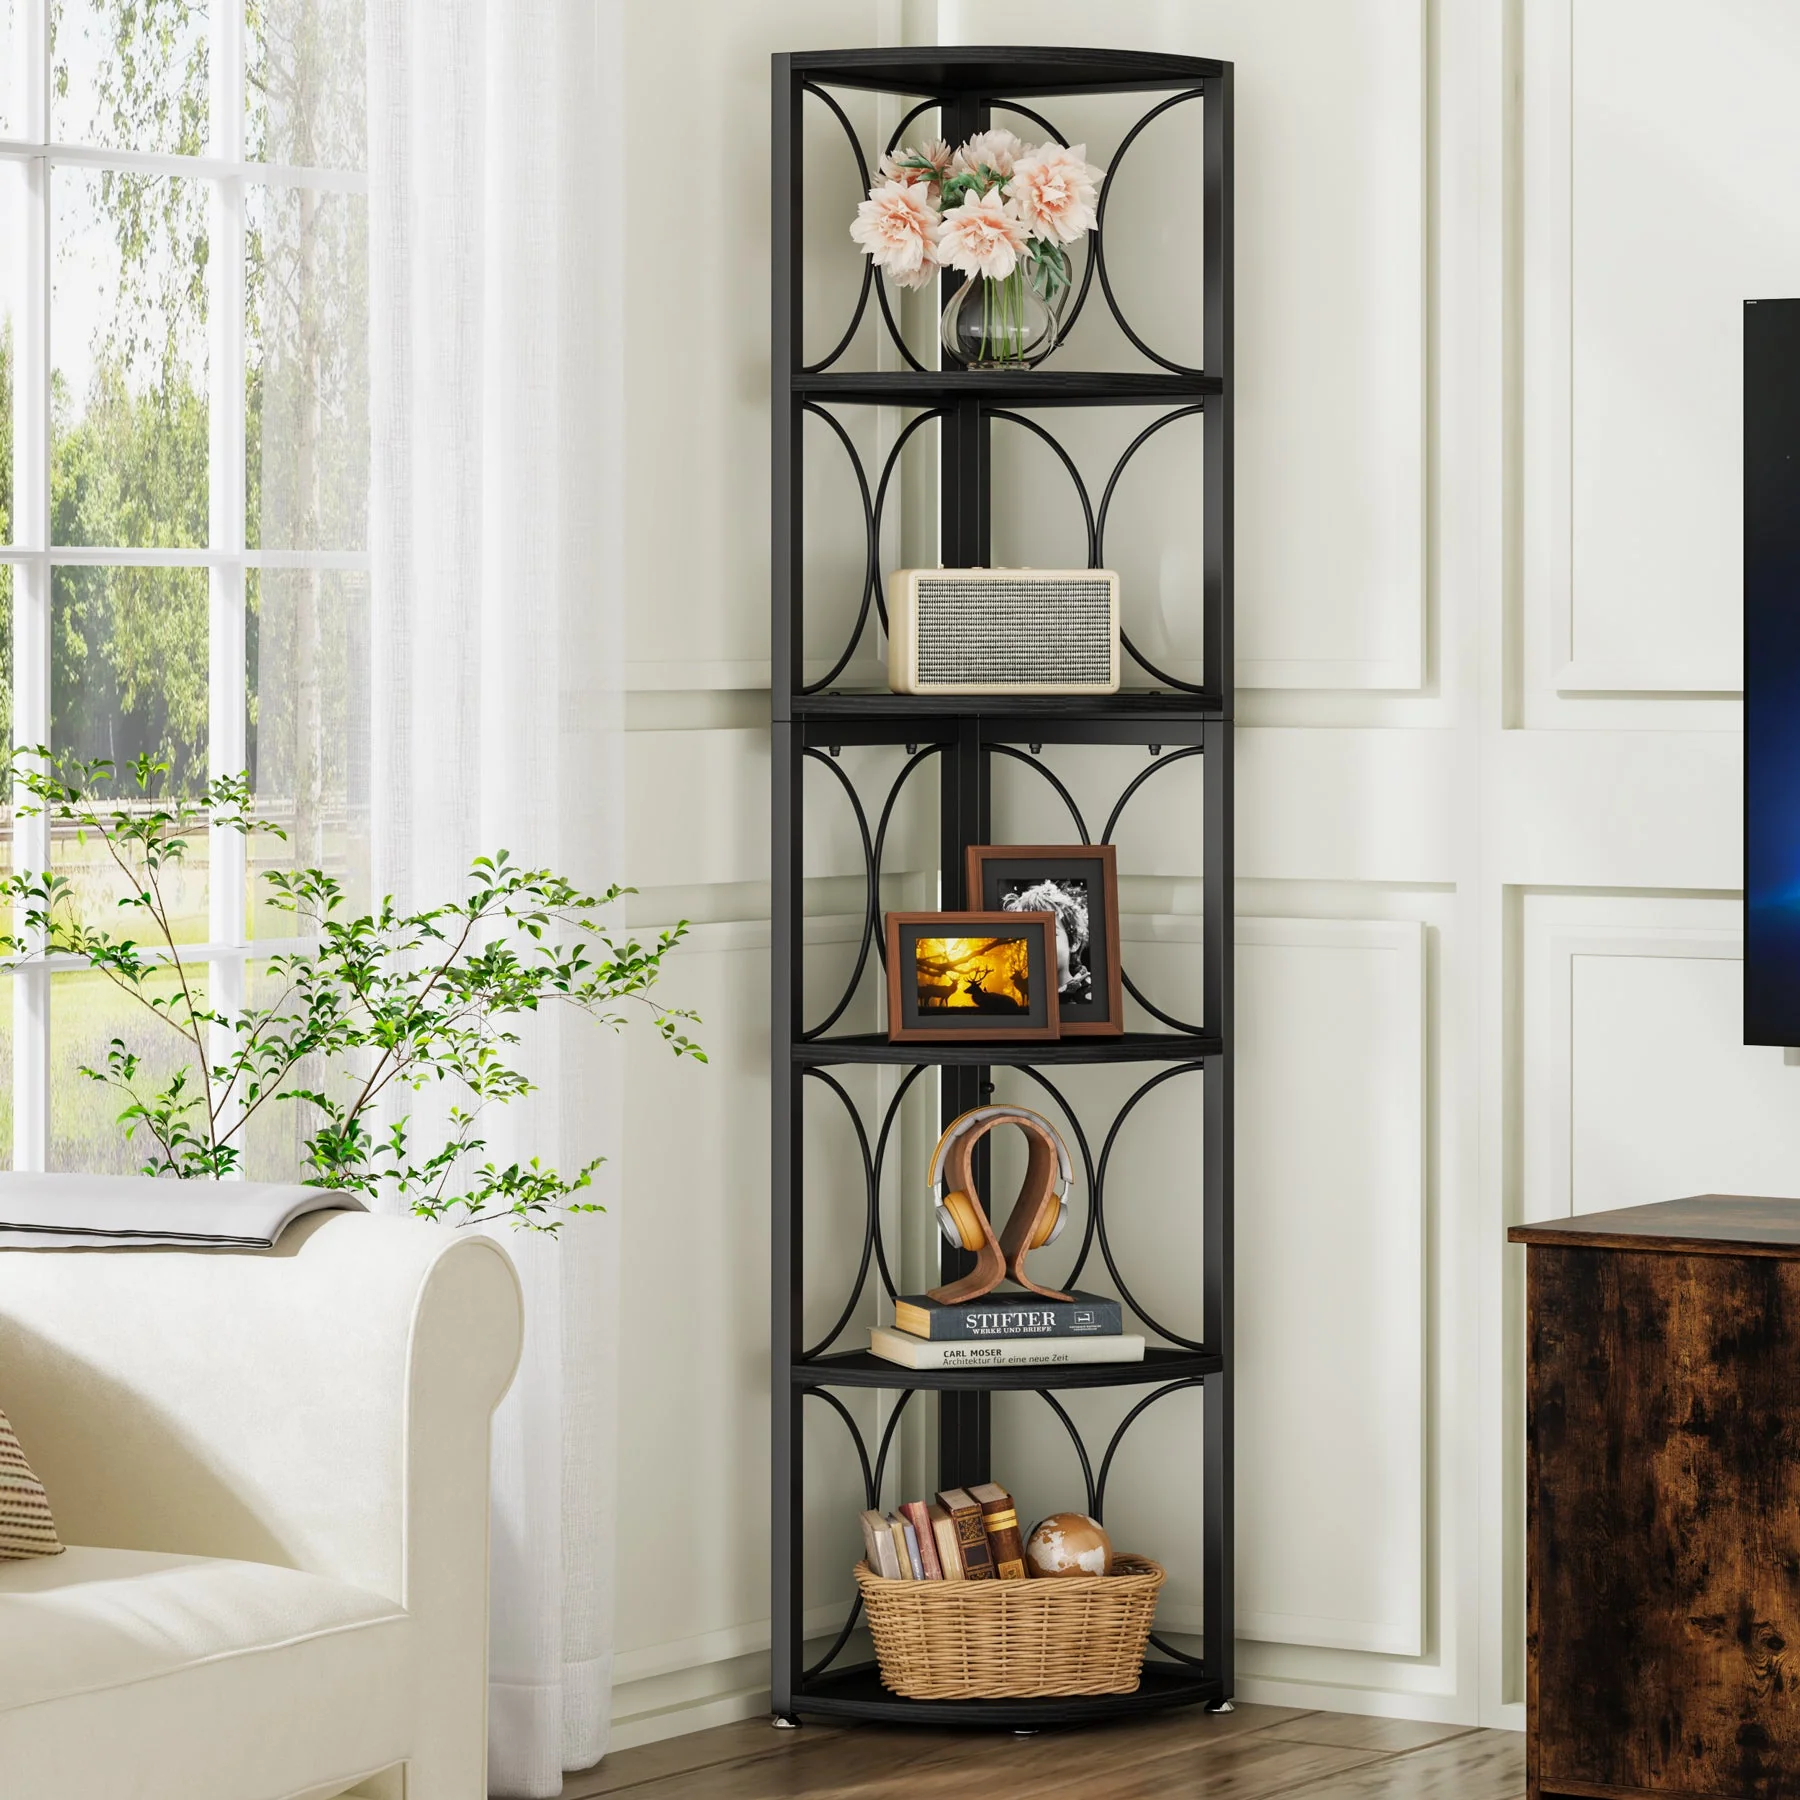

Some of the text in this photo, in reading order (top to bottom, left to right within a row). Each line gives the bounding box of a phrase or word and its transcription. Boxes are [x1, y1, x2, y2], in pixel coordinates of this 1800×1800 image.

[966, 1312, 1056, 1328] STIFTER
[972, 1327, 1001, 1335] WERKE
[943, 1357, 990, 1365] Architektur
